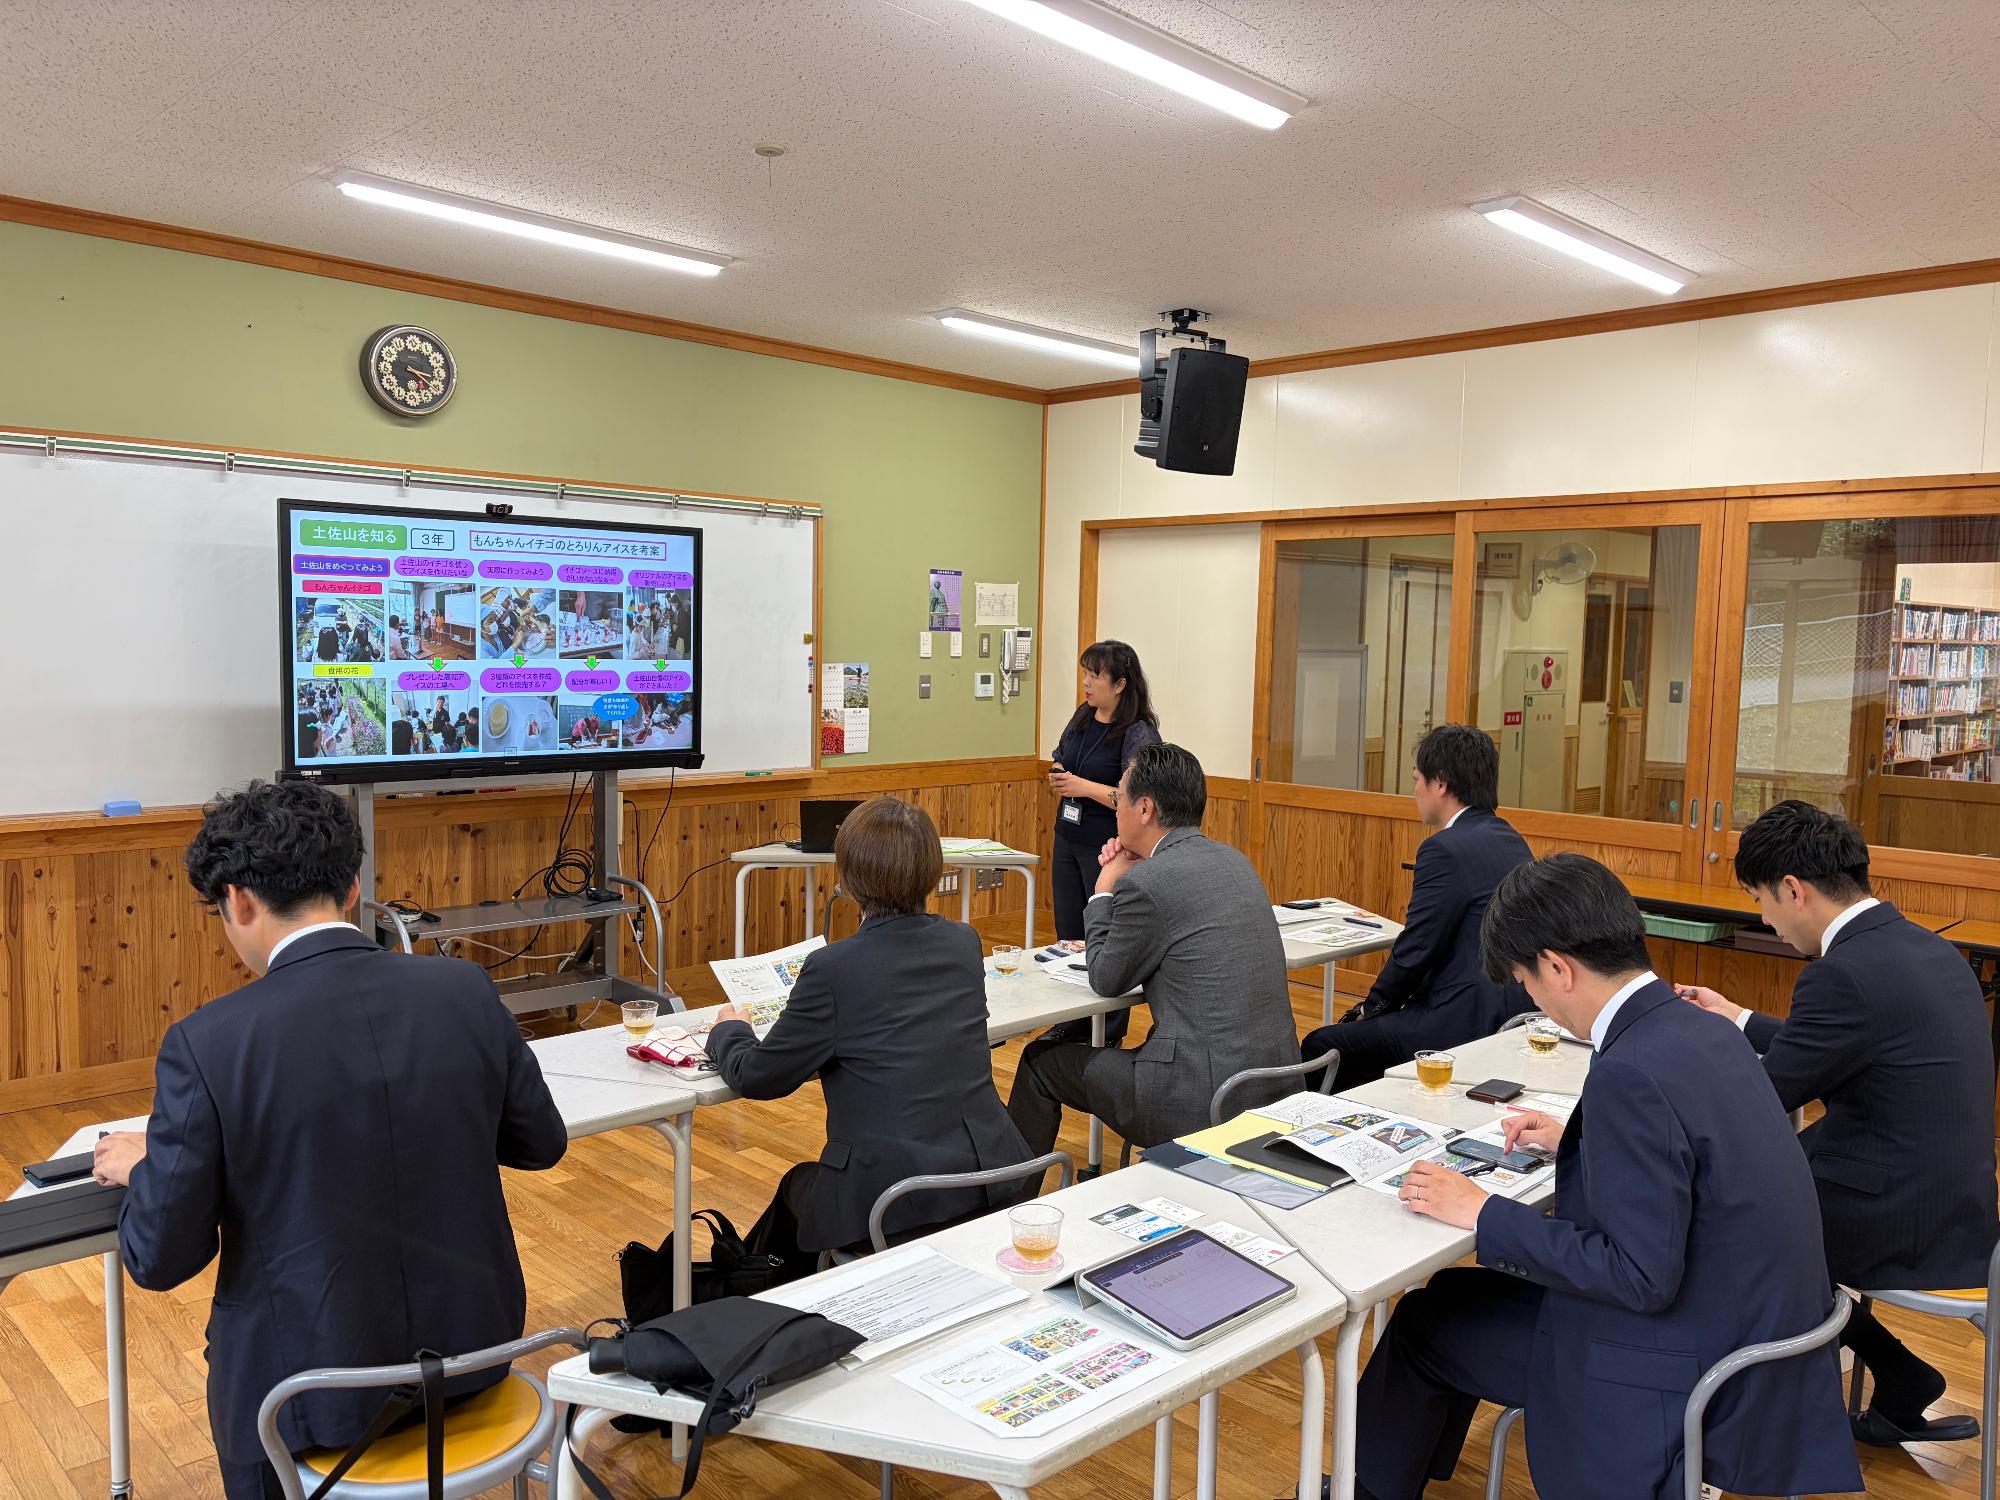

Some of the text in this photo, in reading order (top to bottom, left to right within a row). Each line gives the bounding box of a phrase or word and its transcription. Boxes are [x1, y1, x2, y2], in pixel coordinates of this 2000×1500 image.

[432, 356, 440, 365] 2
[437, 370, 443, 378] 3
[386, 378, 394, 386] 8
[410, 394, 416, 402] 6
[425, 392, 431, 400] 5
[312, 525, 397, 544] 土佐山を知る
[421, 533, 445, 547] 3年
[473, 534, 660, 556] もんちゃんイチゴのとろりんアイスを考案
[300, 561, 383, 572] 土佐山をめぐってみよう
[486, 566, 544, 576] 実際に作ってみよう
[400, 567, 468, 577] てアイスを作りたいな
[314, 583, 371, 592] もんちゃんイチゴ
[328, 666, 359, 675] 食用の花
